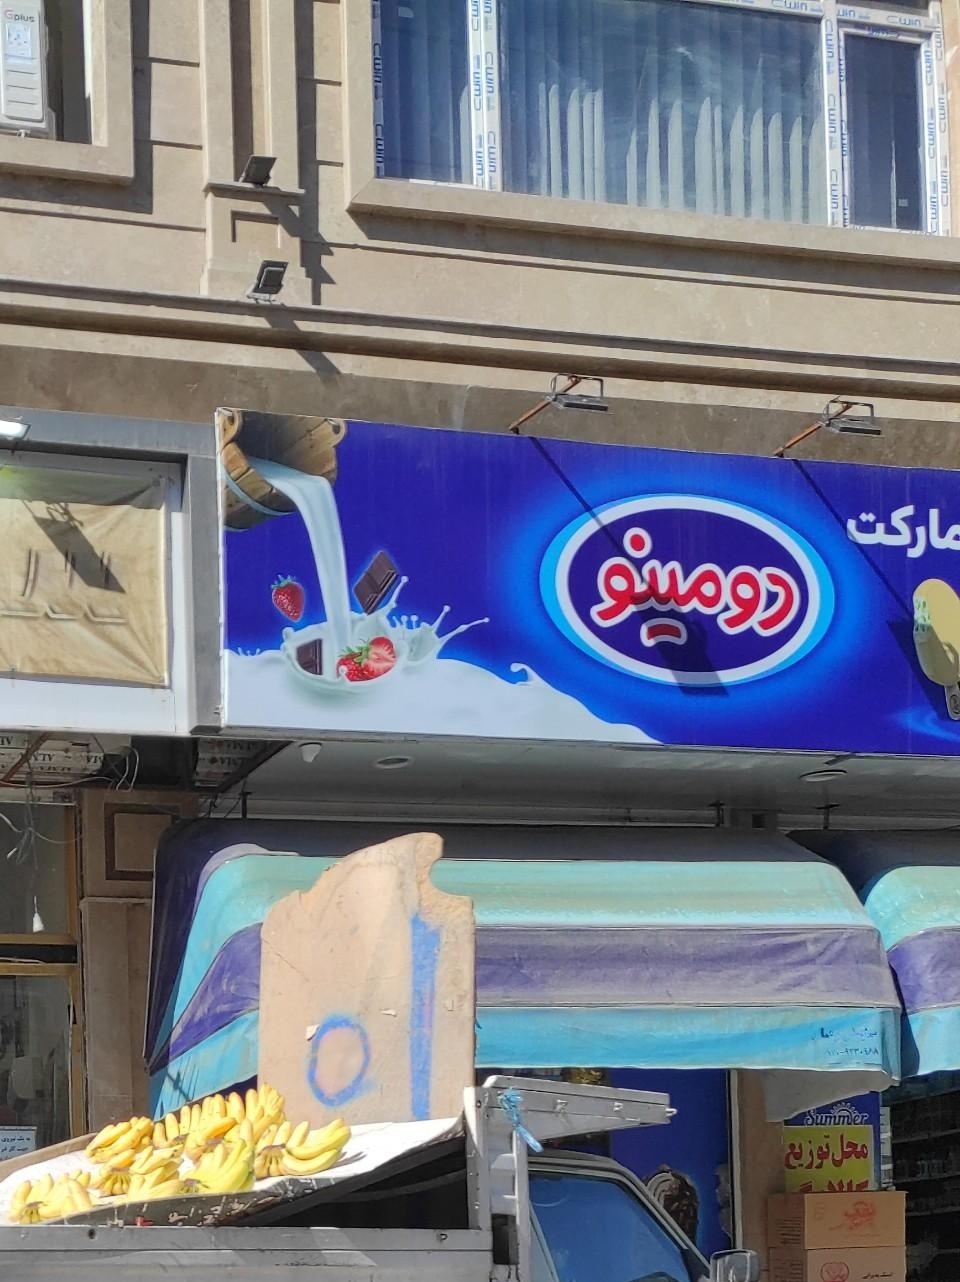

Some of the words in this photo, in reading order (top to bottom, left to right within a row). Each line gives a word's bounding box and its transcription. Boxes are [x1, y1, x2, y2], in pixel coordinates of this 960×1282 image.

[591, 528, 800, 647] دومینو
[803, 1108, 870, 1125] Summer
[784, 1133, 830, 1169] توزیع
[831, 1133, 869, 1168] محل
